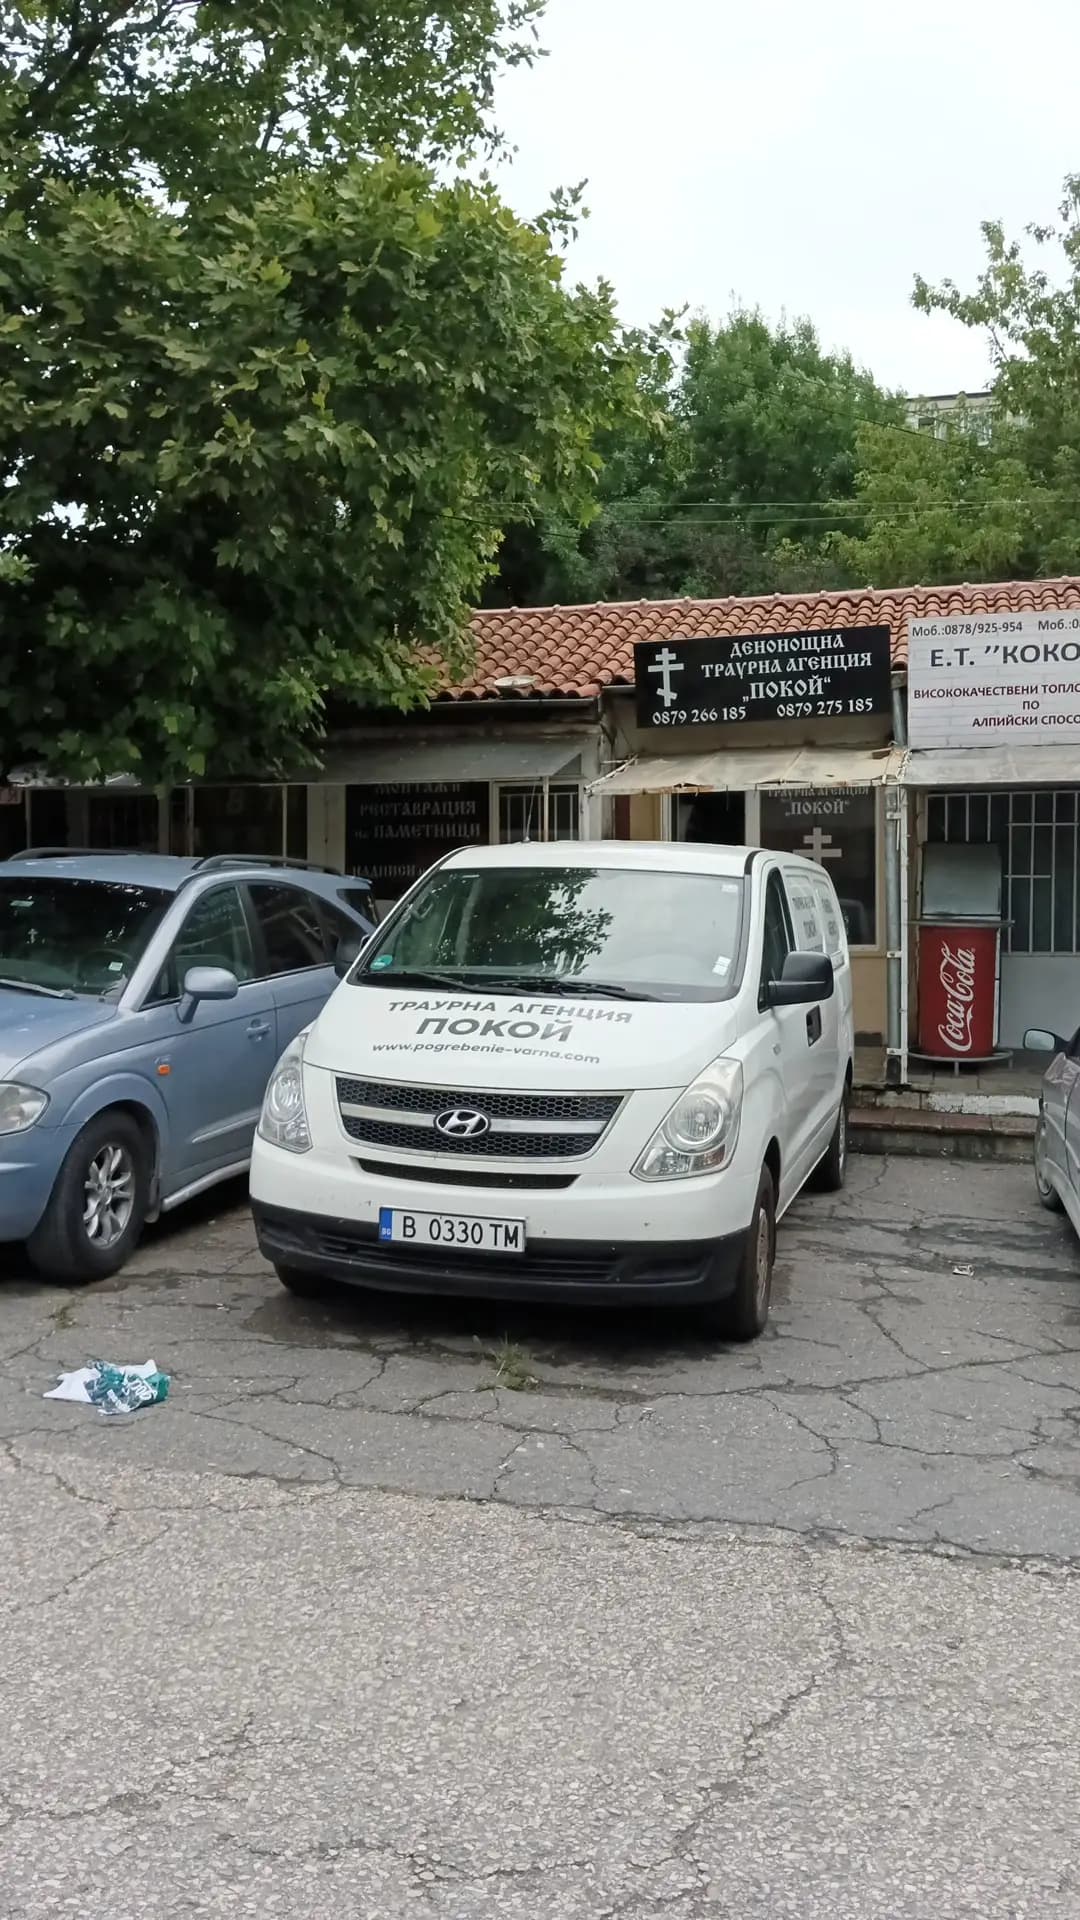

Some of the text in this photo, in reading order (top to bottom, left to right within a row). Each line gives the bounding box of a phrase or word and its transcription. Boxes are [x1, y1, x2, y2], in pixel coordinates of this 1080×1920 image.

[912, 618, 1080, 637] Моб.:0878/925-954 Моб.:0
[730, 633, 846, 659] ДЕНОНОЩНА
[701, 652, 873, 679] ТРАУРНА АГЕНЦИЯ
[930, 647, 975, 668] Е.Т.
[914, 683, 1038, 699] ВИСОКОКАЧЕСТВЕНИ
[652, 705, 747, 726] 0879 266 185
[776, 697, 873, 718] 0879 275 185
[1022, 700, 1040, 710] ПО
[972, 714, 1038, 728] АЛПИЙСКИ
[938, 940, 976, 1051] Coca-Cola
[388, 1000, 633, 1023] ТРАУРНА АГЕНЦИЯ
[416, 1017, 573, 1042] ПОКОЙ
[372, 1041, 600, 1064] www.pogrebenie-varna.com
[429, 1218, 483, 1245] 0330
[489, 1223, 519, 1248] TM
